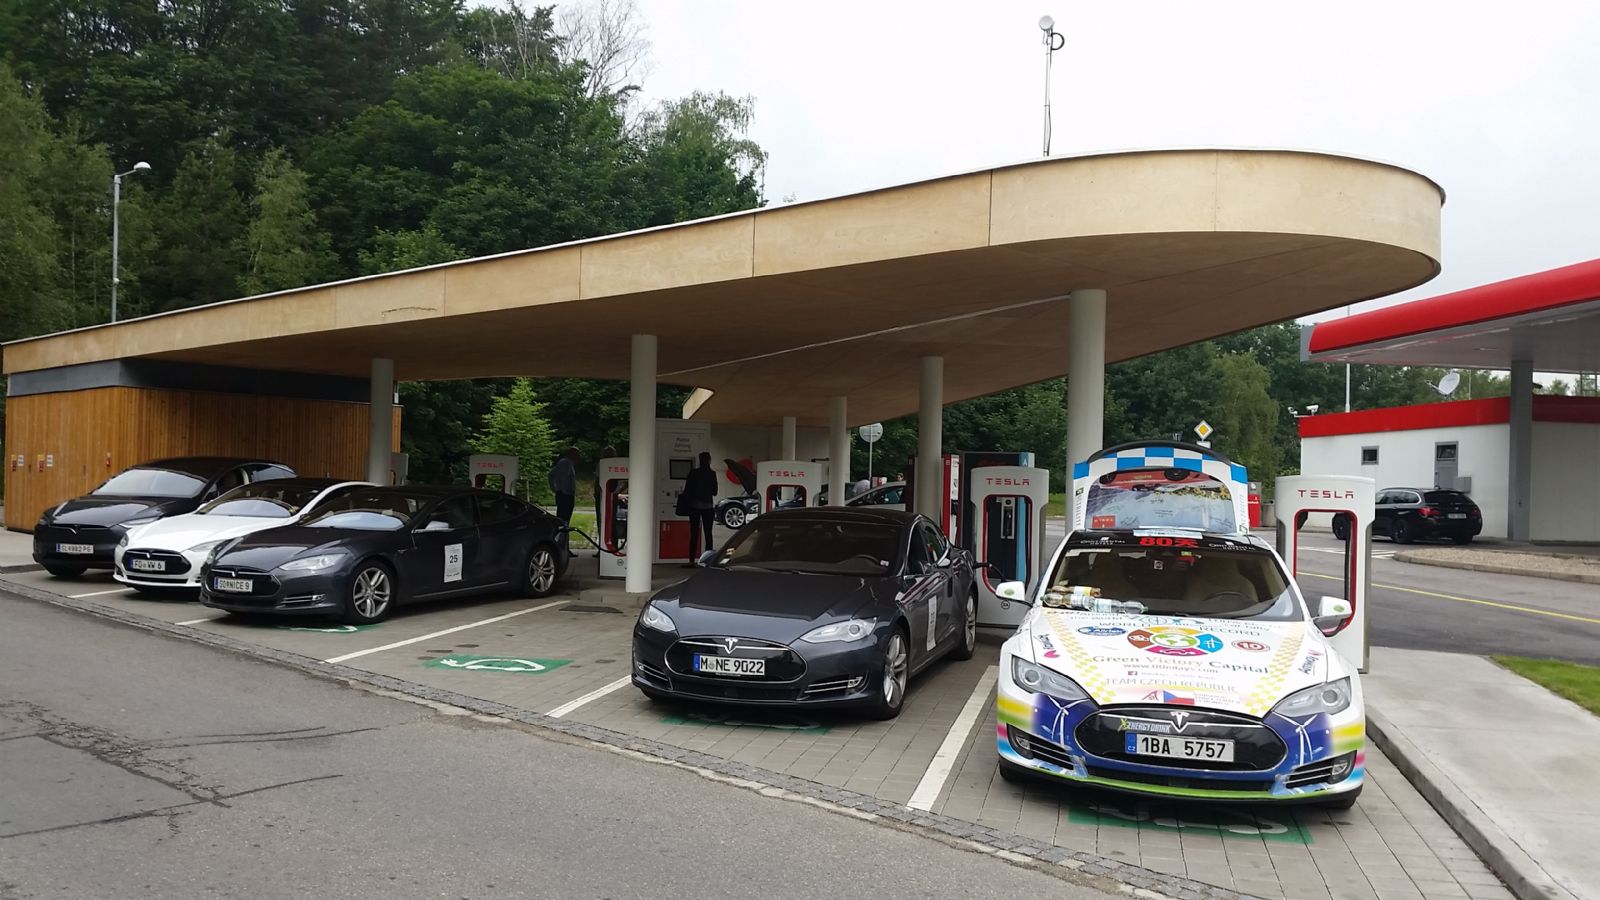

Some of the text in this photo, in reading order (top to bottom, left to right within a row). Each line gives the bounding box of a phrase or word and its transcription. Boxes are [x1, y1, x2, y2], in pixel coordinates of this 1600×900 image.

[1298, 489, 1354, 498] TESLA
[450, 554, 458, 563] 25
[245, 582, 250, 590] 9
[1200, 626, 1260, 636] RECORD
[701, 658, 763, 673] M NE 9022
[1146, 656, 1203, 667] Victory
[1209, 660, 1269, 674] Capital
[1140, 678, 1177, 687] CZECH
[1180, 680, 1238, 692] REPUBLIC
[1141, 737, 1226, 758] 1BA 5757
